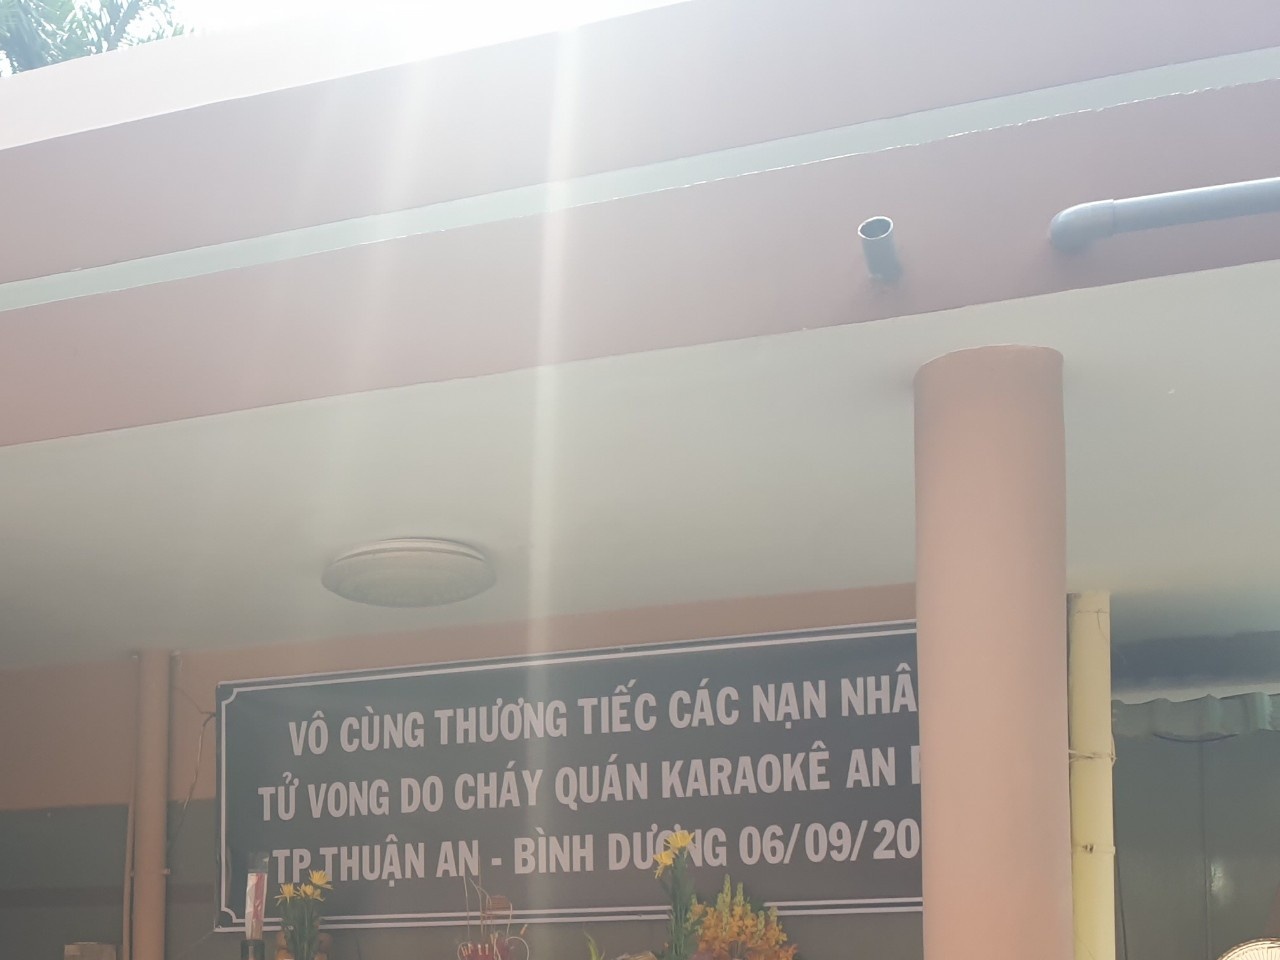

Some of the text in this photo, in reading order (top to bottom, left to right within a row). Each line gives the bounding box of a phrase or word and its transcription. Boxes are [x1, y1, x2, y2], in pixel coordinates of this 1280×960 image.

[288, 709, 329, 756] VÔ
[339, 705, 425, 753] CÙNG
[434, 697, 567, 745] THƯƠNG
[577, 678, 657, 735] TIẾC
[668, 677, 740, 730] CÁC
[752, 679, 827, 730] NẠN
[257, 771, 300, 821] TỬ
[307, 778, 390, 819] VONG
[400, 775, 444, 814] DO
[454, 760, 544, 811] CHÁY
[554, 753, 648, 811] QUÁN
[661, 740, 830, 800] KARAOKÊ
[846, 746, 896, 789] AN
[436, 839, 479, 878] AN
[513, 826, 593, 875] BÌNH
[738, 817, 920, 866] 06/09/20
